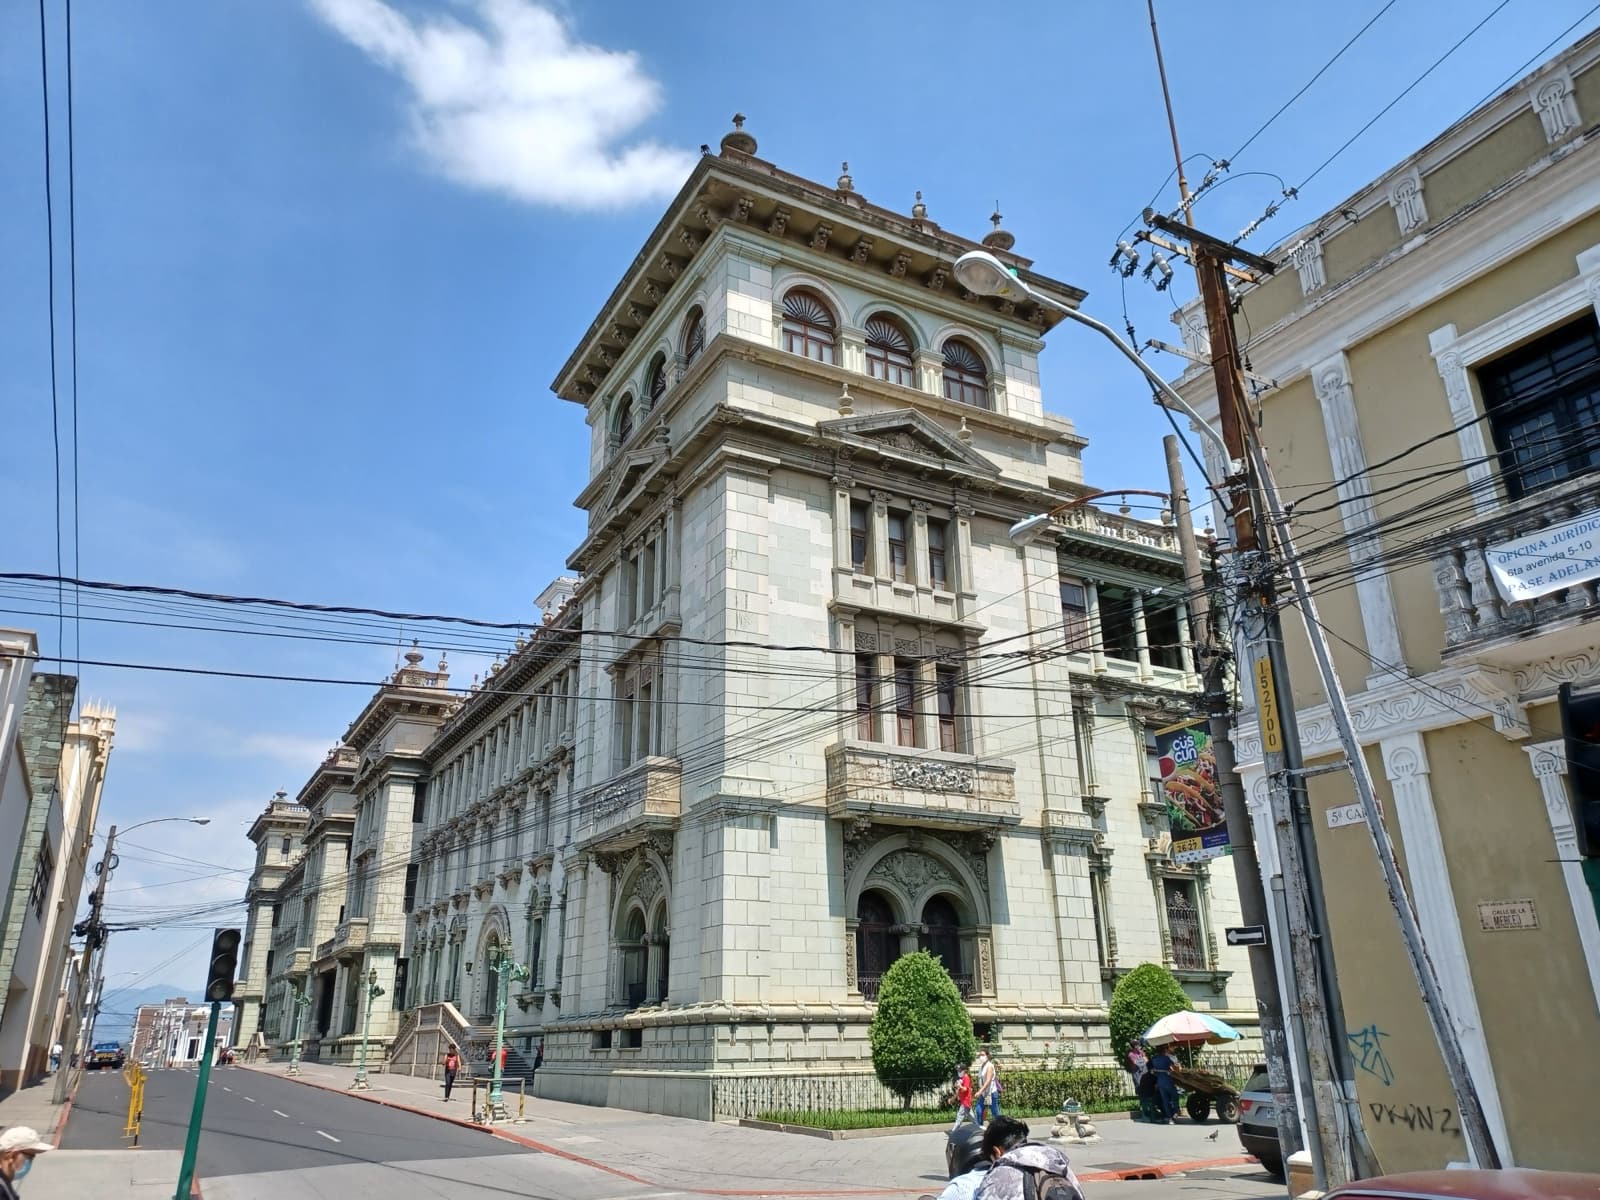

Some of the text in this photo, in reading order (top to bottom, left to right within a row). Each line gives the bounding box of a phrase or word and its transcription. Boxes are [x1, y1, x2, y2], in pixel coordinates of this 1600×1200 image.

[1498, 519, 1600, 564] OFICINA JURÍDIC
[1507, 540, 1592, 577] 6ta avenida 5-10
[1508, 576, 1545, 593] PASE
